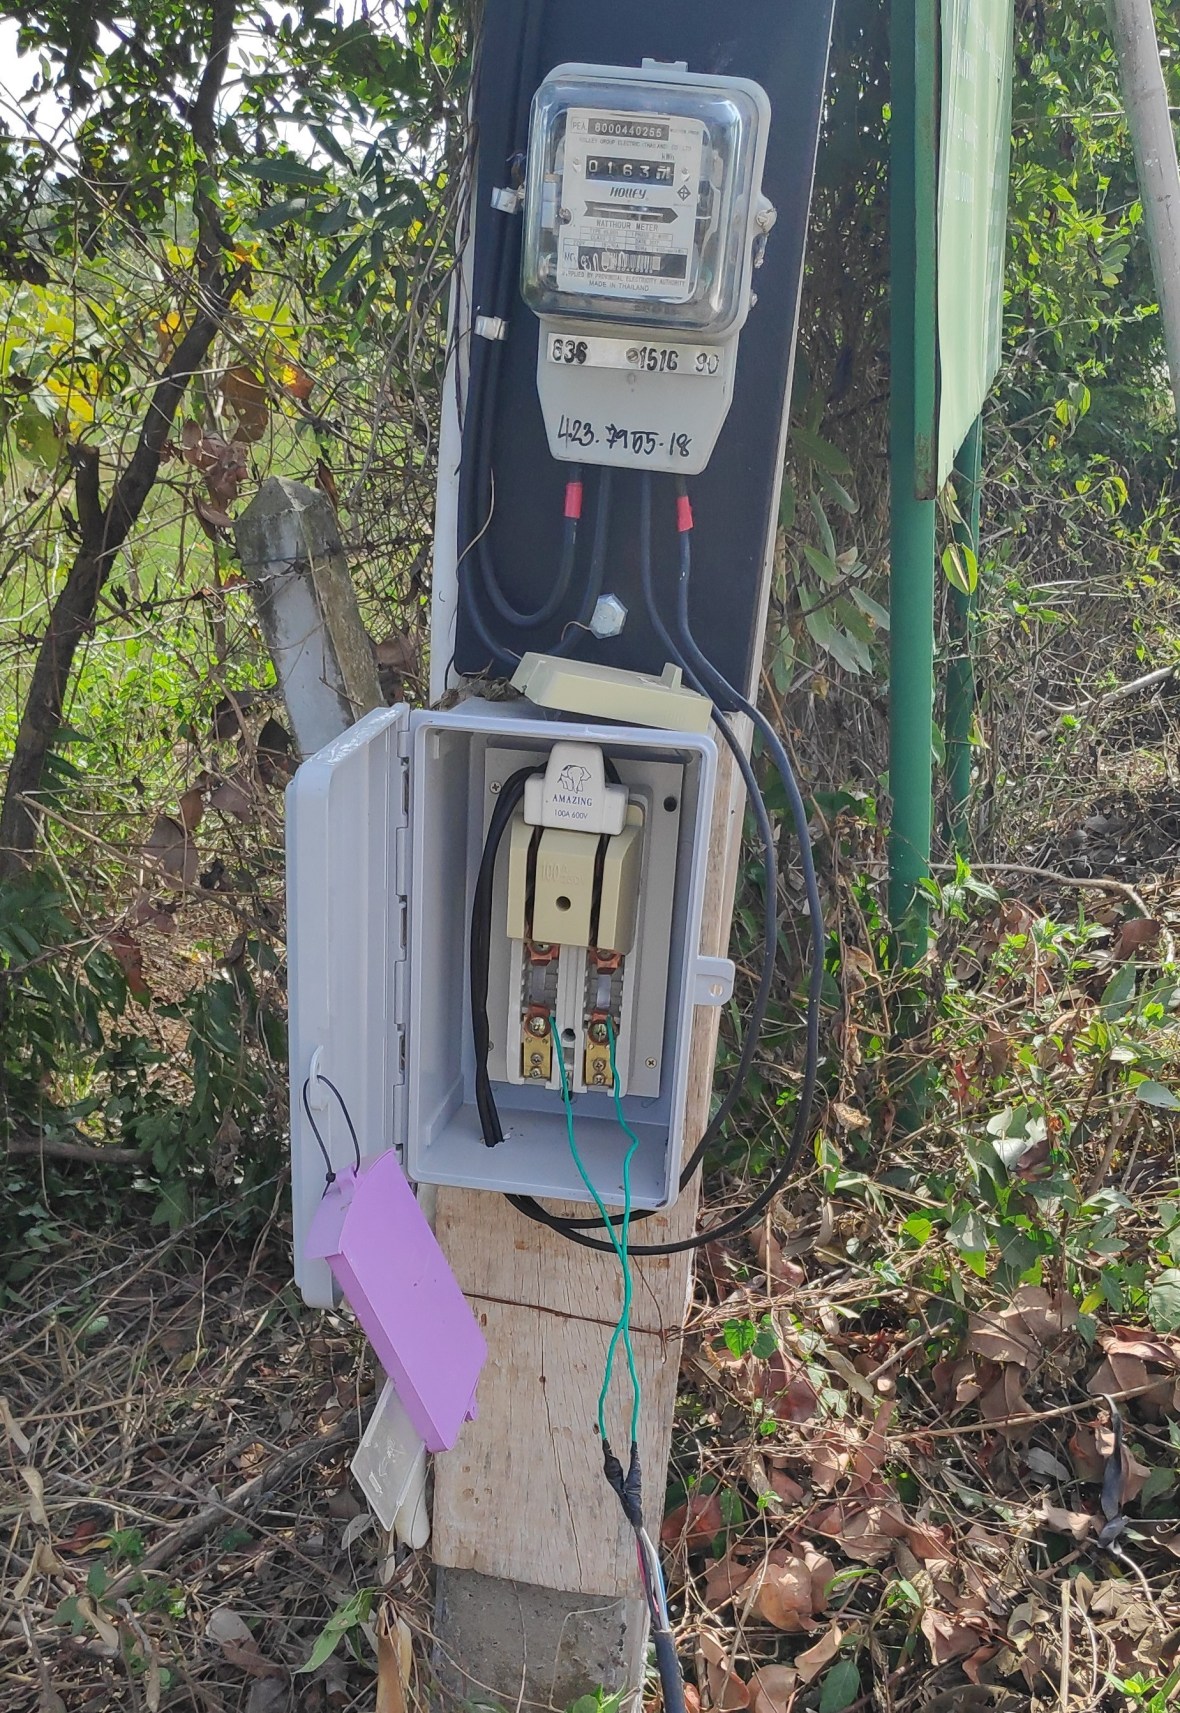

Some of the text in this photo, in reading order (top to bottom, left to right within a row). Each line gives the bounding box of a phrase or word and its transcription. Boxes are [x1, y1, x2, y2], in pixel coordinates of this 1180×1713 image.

[596, 219, 659, 232] WATTHOUR METER
[588, 280, 607, 289] MADE
[618, 283, 650, 292] THAILAND
[552, 793, 593, 807] AMAZING
[554, 809, 588, 820] 100A 600V
